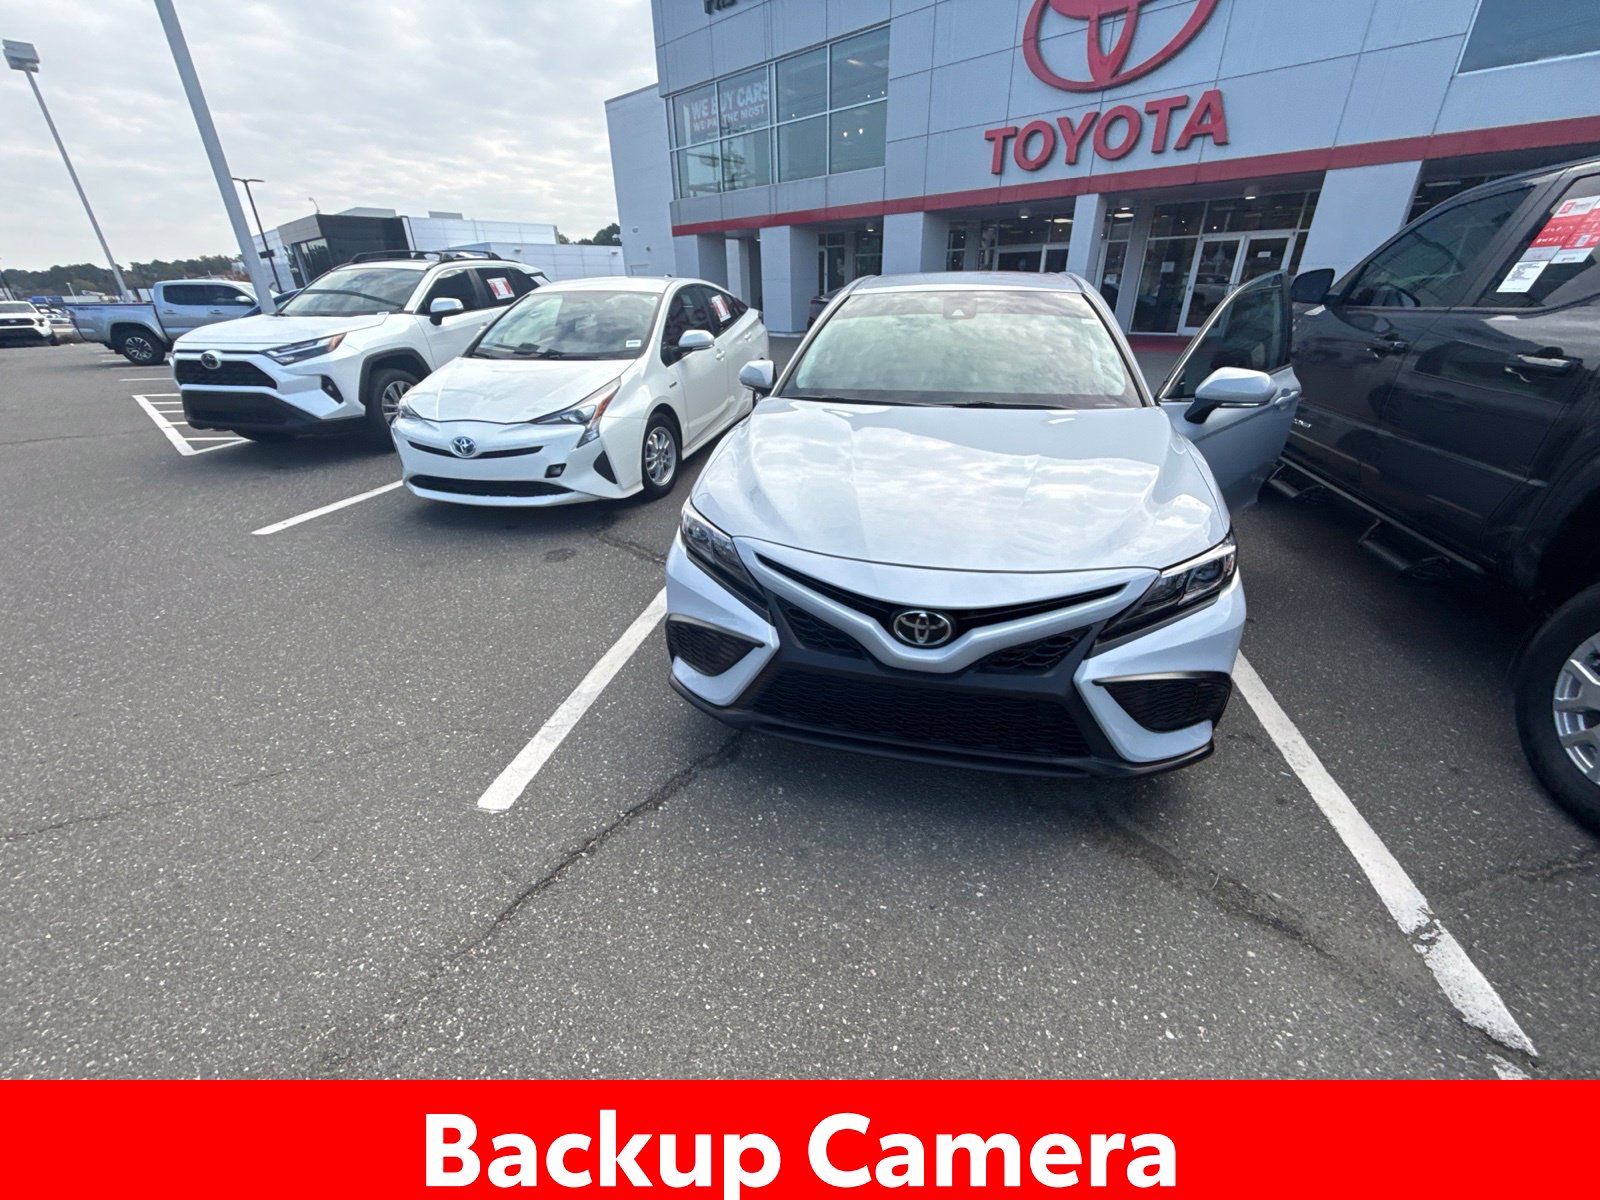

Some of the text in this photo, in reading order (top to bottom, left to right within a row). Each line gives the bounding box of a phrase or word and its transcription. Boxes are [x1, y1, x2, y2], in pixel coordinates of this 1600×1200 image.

[690, 80, 769, 120] WE BUY CARS
[693, 120, 705, 132] WE
[722, 111, 739, 127] THE
[740, 103, 766, 119] MOST
[984, 88, 1229, 175] TOYOTA
